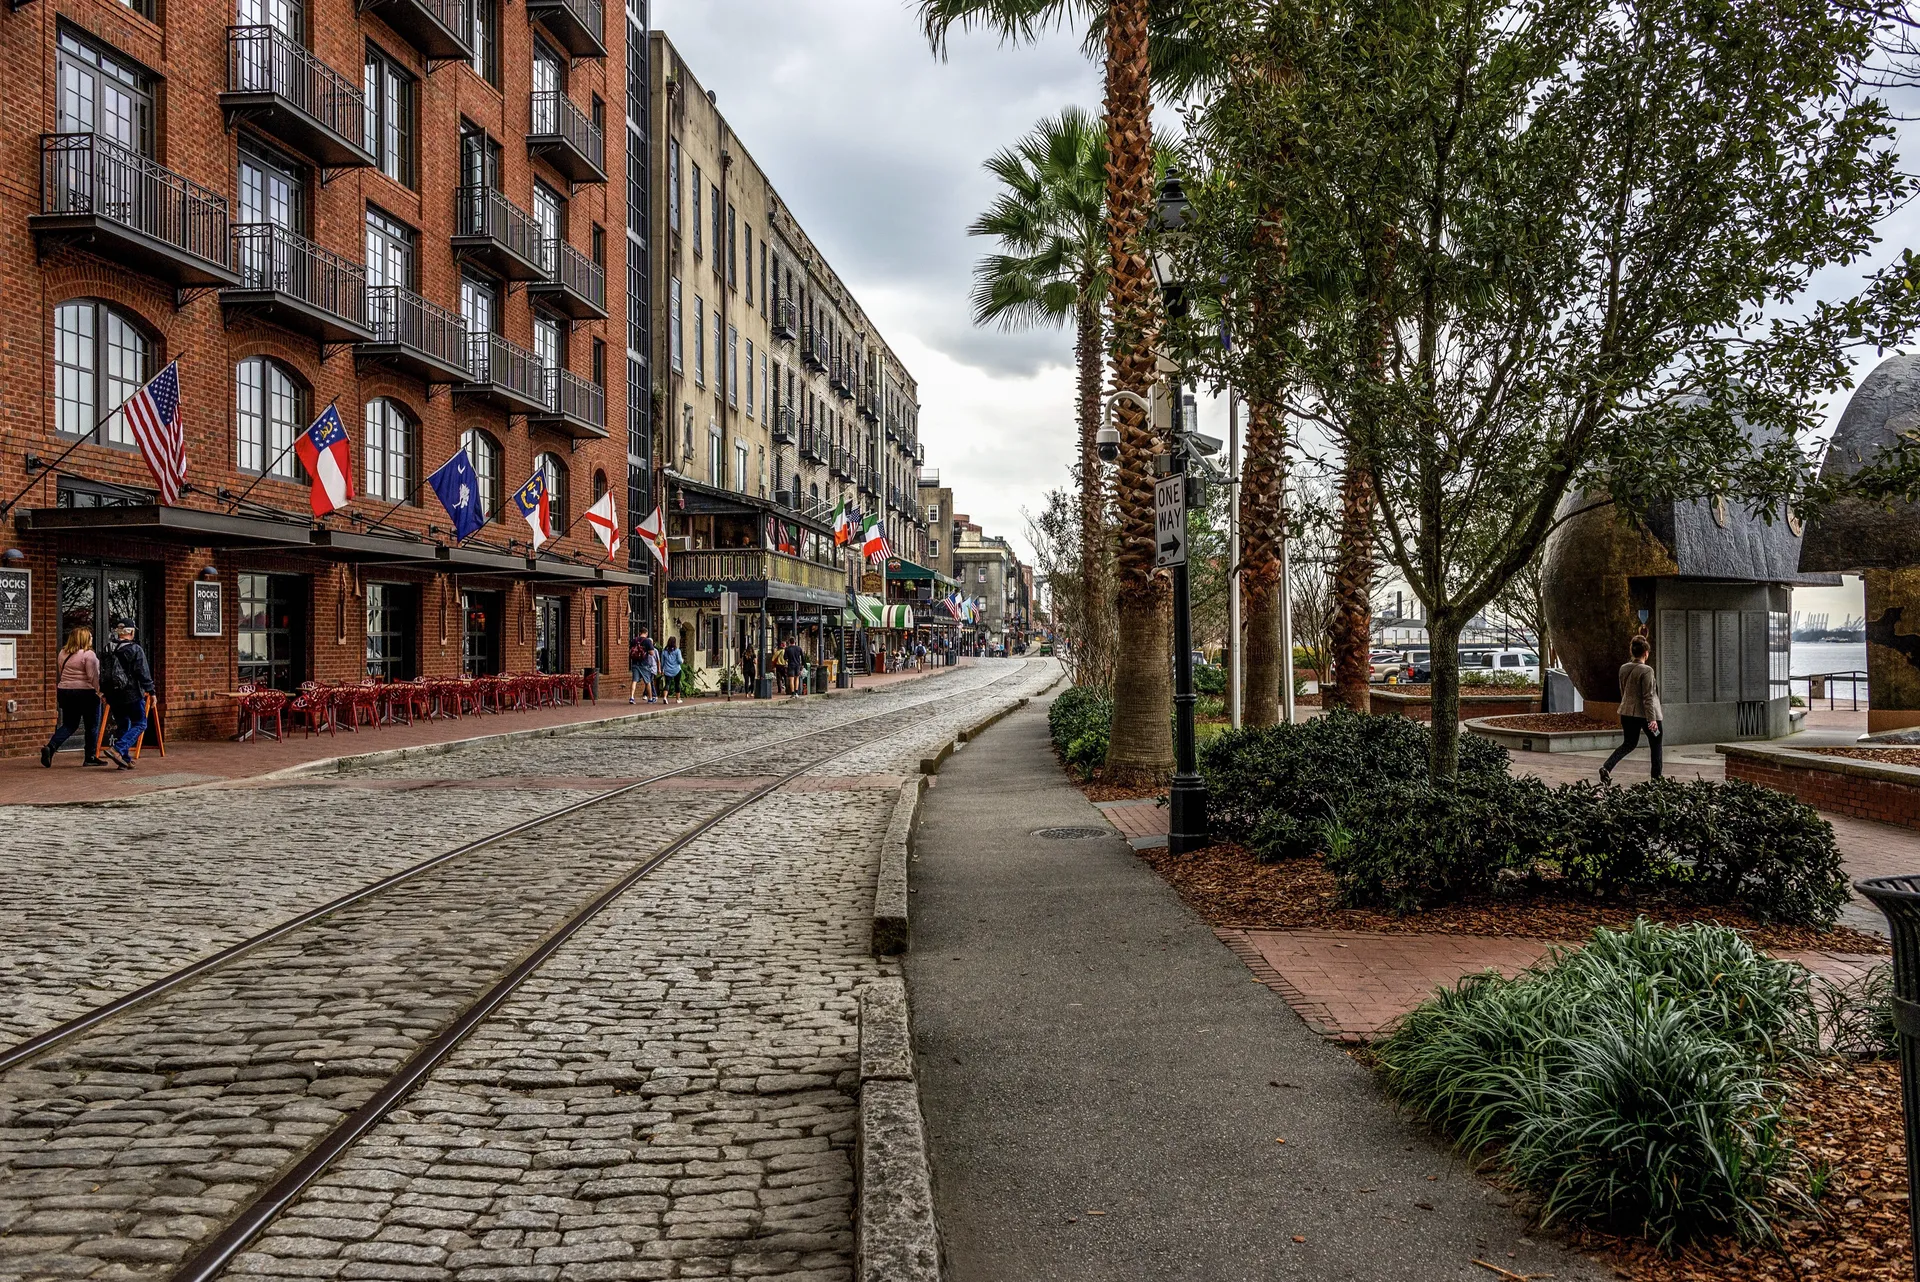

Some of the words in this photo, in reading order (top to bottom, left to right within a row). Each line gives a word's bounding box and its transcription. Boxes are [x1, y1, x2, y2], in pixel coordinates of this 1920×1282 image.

[1158, 483, 1180, 507] ONE
[1158, 508, 1181, 532] WAY
[0, 579, 26, 588] OCKS
[198, 590, 218, 599] ROCKS
